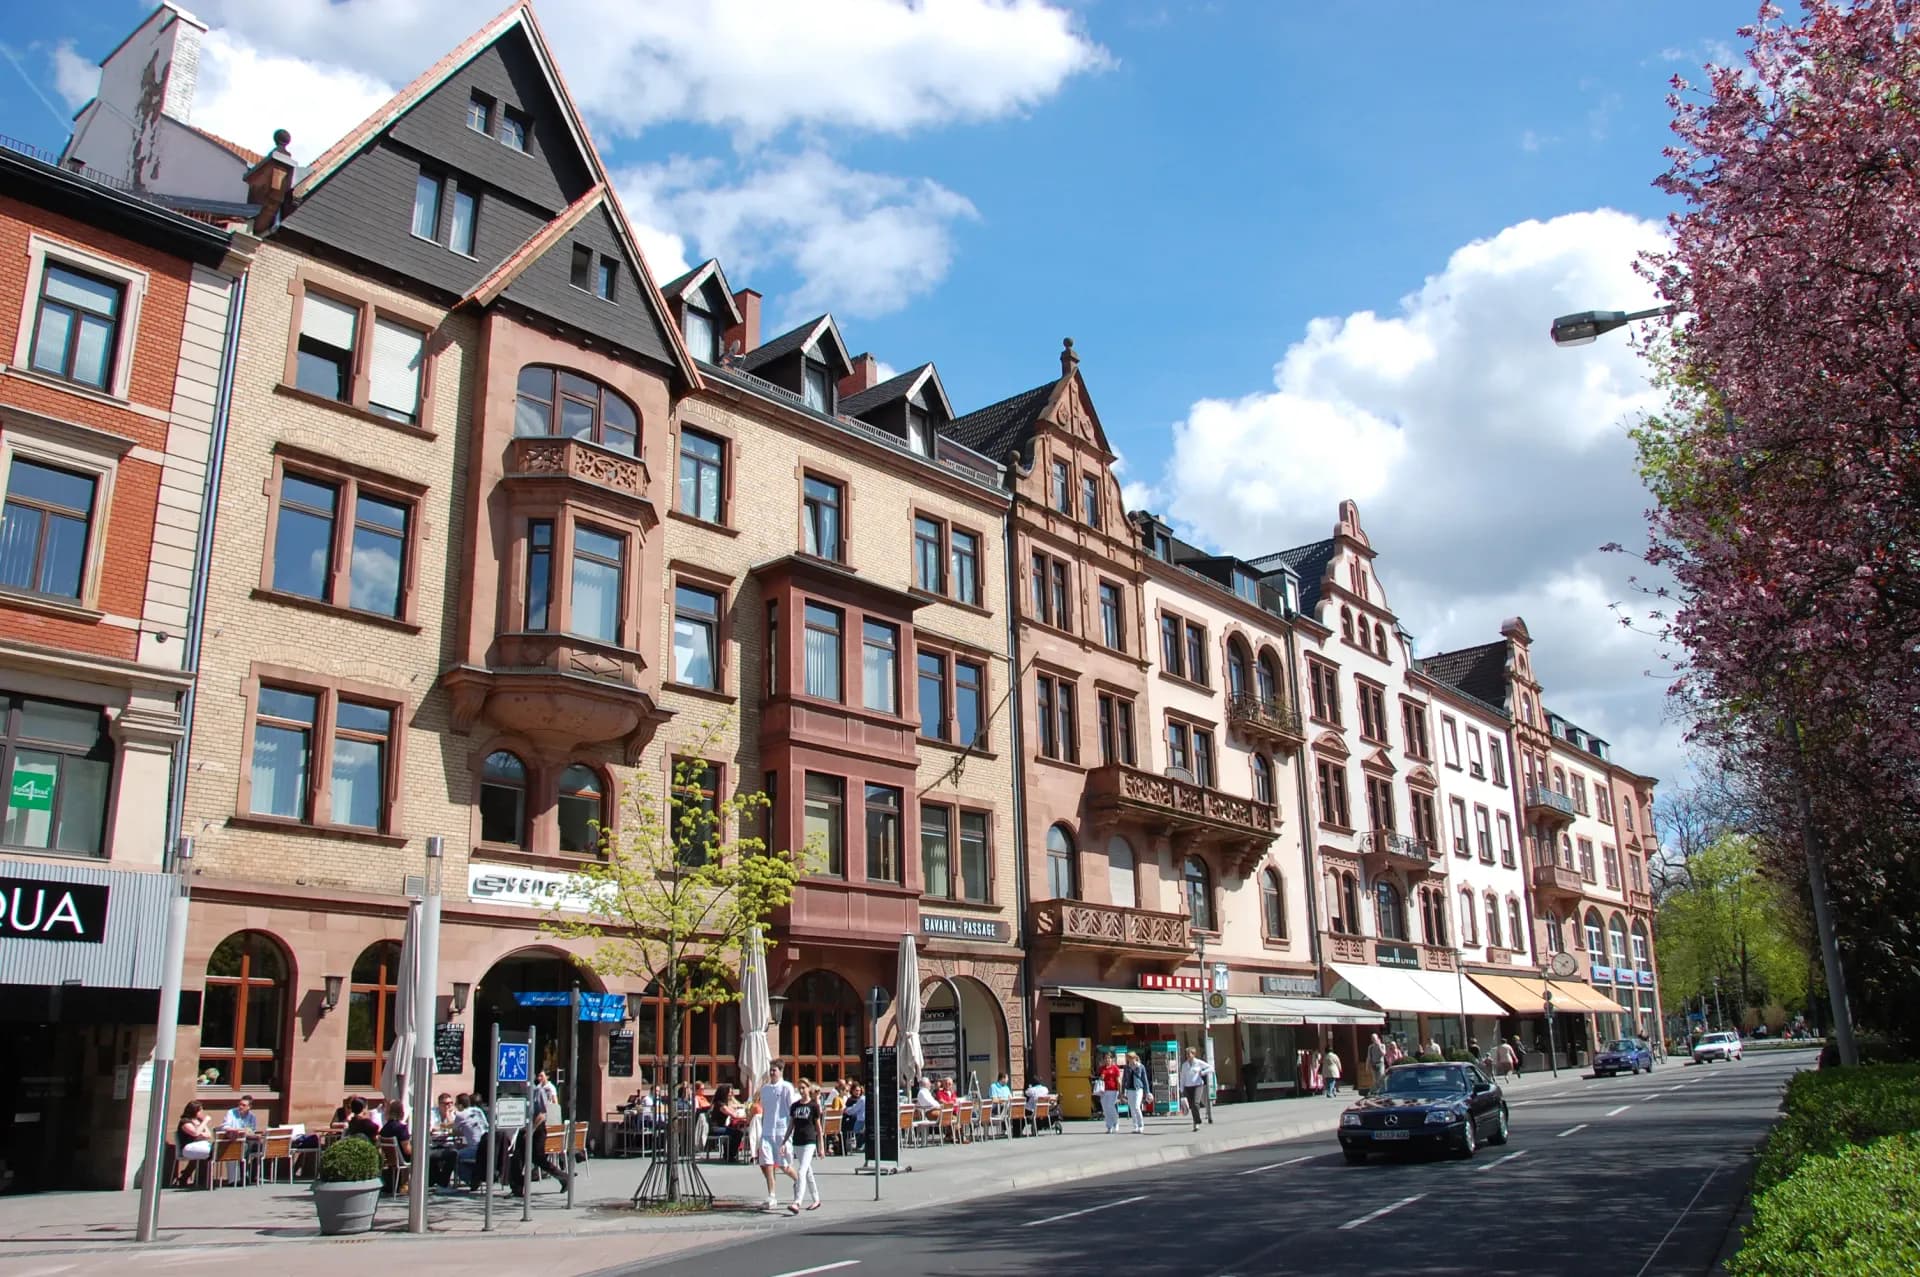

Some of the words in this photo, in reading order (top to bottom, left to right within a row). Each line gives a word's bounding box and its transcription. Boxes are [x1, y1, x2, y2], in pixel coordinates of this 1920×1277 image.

[0, 887, 84, 934] UA
[924, 918, 957, 933] BAVARIA
[963, 921, 995, 937] PASSAGE
